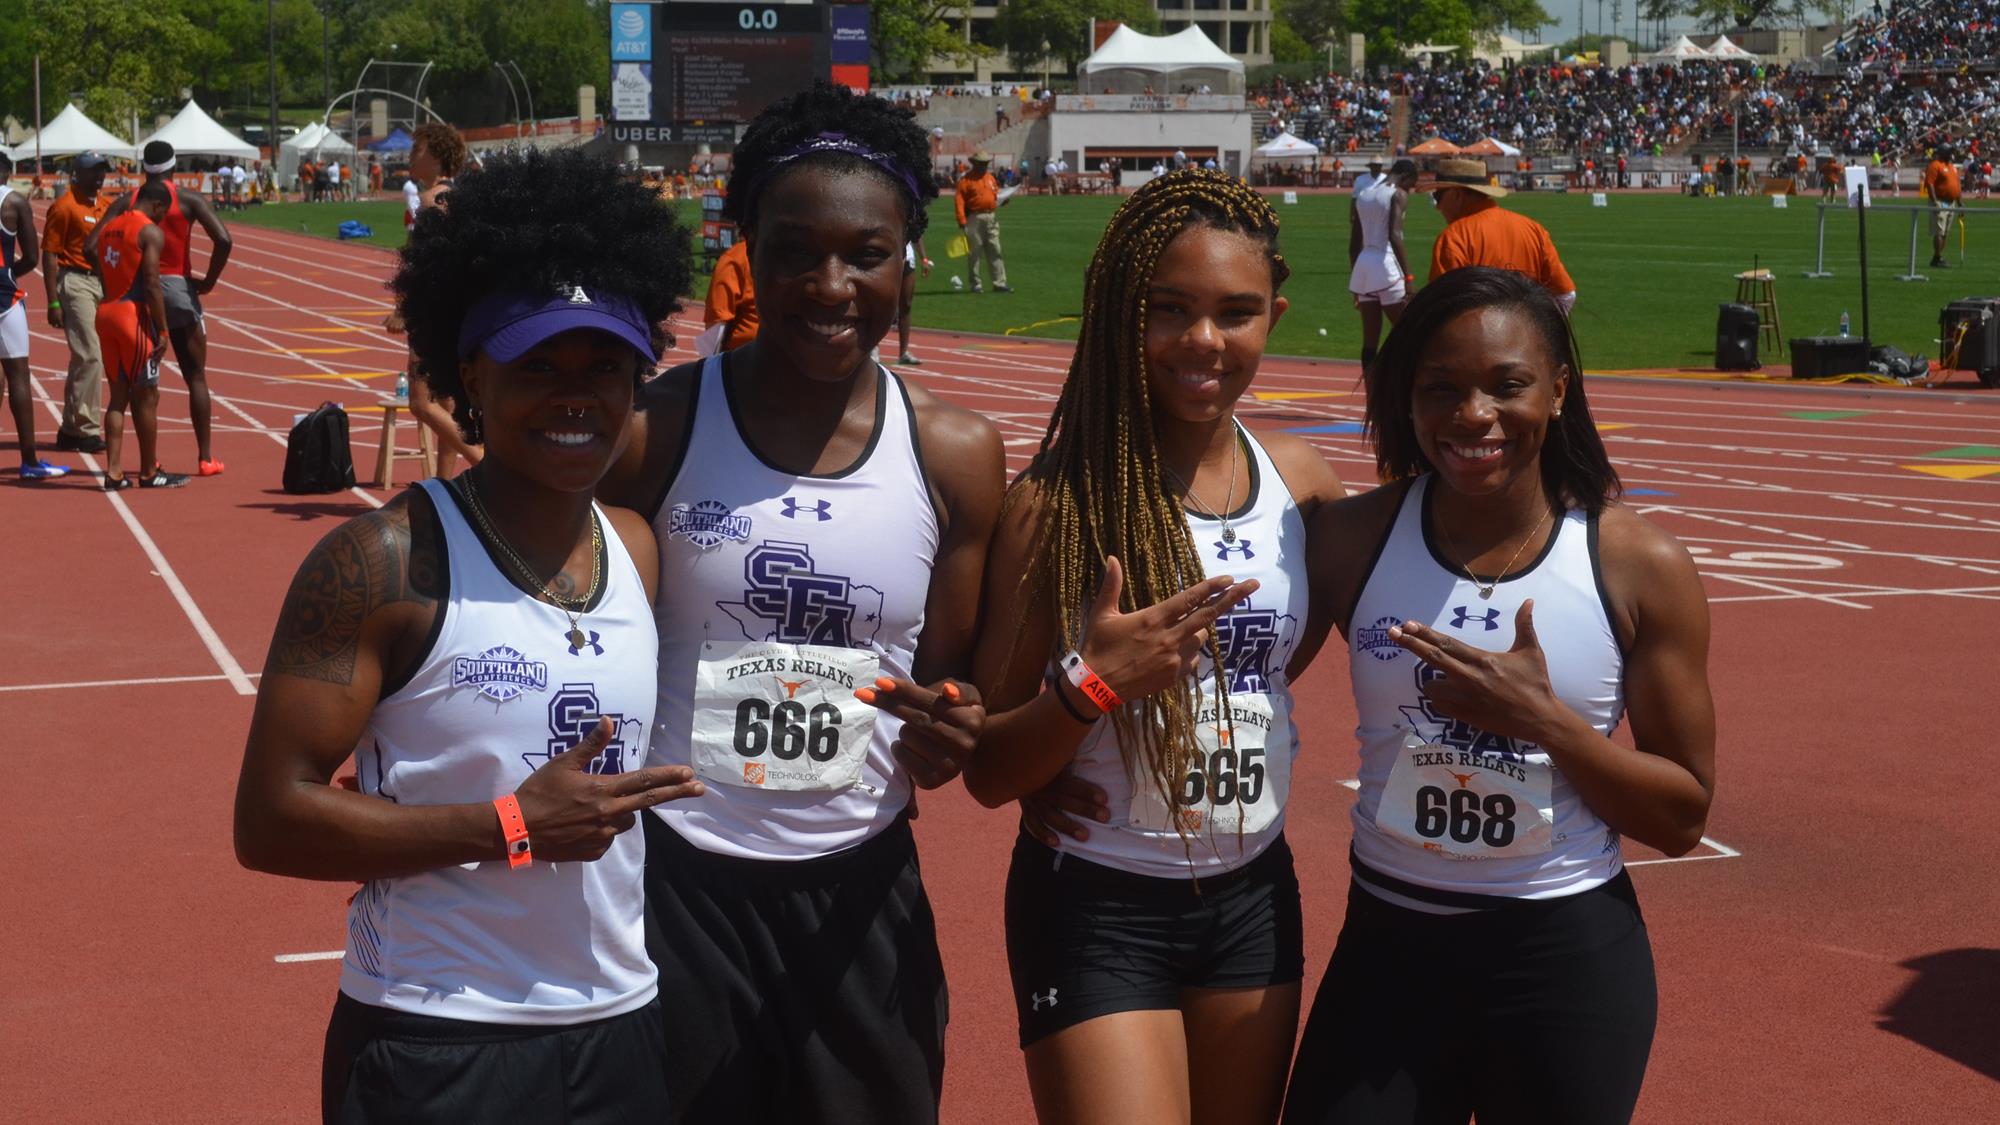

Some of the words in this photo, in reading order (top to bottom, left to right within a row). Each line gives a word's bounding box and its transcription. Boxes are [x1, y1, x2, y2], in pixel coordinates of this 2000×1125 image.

[738, 9, 778, 29] 0.0
[616, 41, 647, 54] AT&T
[614, 127, 671, 141] UBER
[671, 510, 750, 538] SOUTHLAND
[682, 525, 735, 535] CONFERENCE
[743, 545, 856, 646] SFA
[456, 657, 545, 688] SOUTHLAND
[472, 674, 532, 684] CONFERENCE
[726, 658, 786, 681] TEXAS
[791, 658, 855, 690] RELAYS
[733, 698, 842, 762] 666
[768, 771, 821, 782] TECHNOLOGY
[1459, 752, 1526, 782] RELAYS
[1415, 785, 1516, 847] 668
